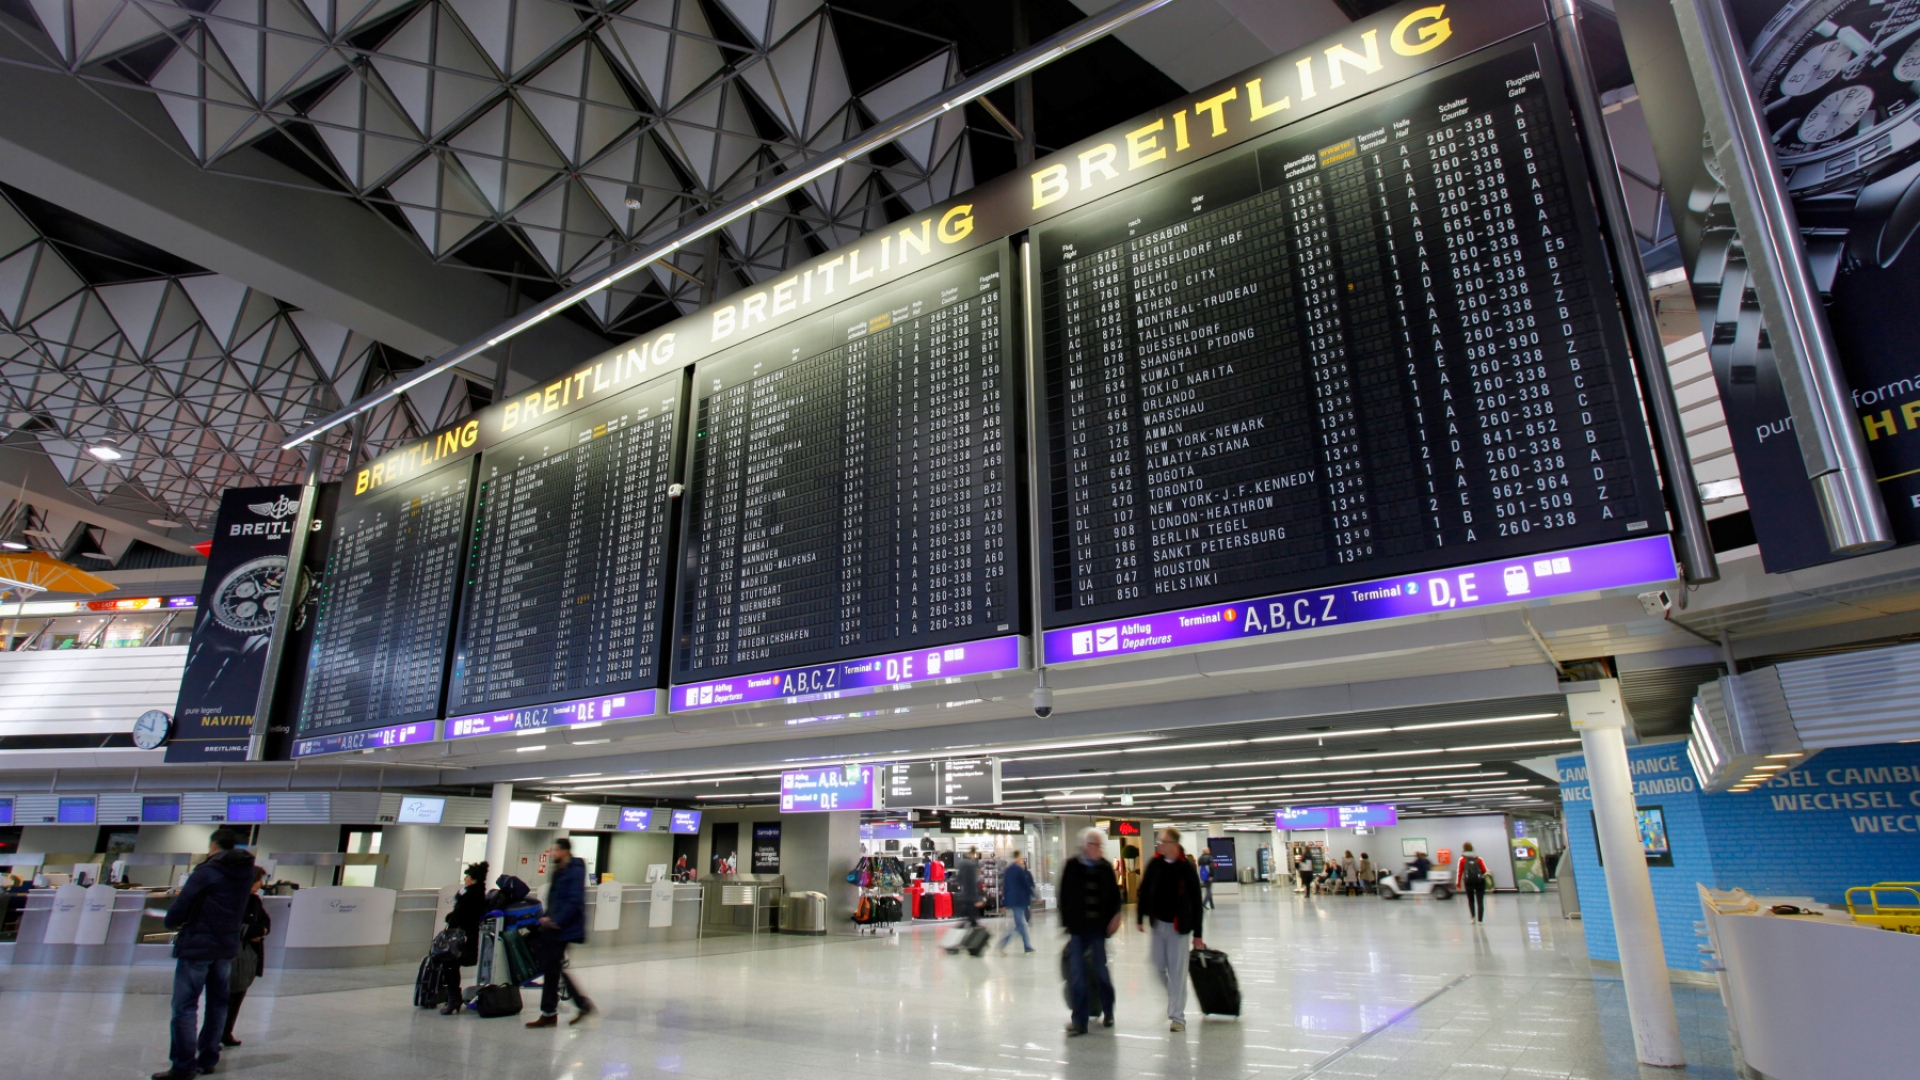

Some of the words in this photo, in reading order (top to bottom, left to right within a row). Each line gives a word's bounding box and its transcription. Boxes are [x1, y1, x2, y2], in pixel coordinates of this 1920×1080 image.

[1506, 71, 1540, 88] Flugsteig
[1508, 86, 1526, 98] Gate
[1032, 4, 1452, 209] BREITLING
[1438, 98, 1468, 112] Schalter
[1441, 107, 1469, 122] Counter
[1358, 127, 1385, 142] Terminal
[1360, 136, 1388, 152] Terminal
[1320, 141, 1351, 156] erwartet
[1322, 148, 1356, 166] estimated
[1131, 223, 1187, 250] LISSABON
[1427, 114, 1492, 145] 260-338
[1132, 240, 1172, 263] BEIRUT
[1133, 241, 1210, 275] DUESSELDORF
[1220, 230, 1241, 245] HBF
[711, 204, 974, 342] BREITLING
[1102, 325, 1121, 339] 875
[1137, 283, 1256, 328] MONTREAL-TRUDEAU
[1444, 203, 1511, 232] 665-678
[1134, 270, 1167, 288] DELHI
[1135, 280, 1177, 301] MEXICO
[1185, 267, 1215, 285] CITX
[1070, 378, 1082, 389] MU
[1104, 365, 1124, 379] 220
[1140, 345, 1197, 369] SHANGHAI
[1207, 328, 1254, 349] PTDONG
[1395, 284, 1402, 295] 2
[1422, 276, 1431, 287] D
[1453, 250, 1521, 278] 854-859
[1545, 237, 1564, 252] E5
[1136, 296, 1171, 314] ATHEN
[1138, 318, 1188, 341] TALLINN
[1138, 323, 1218, 355] DUESSELDORF
[501, 332, 676, 432] BREITLING
[1141, 362, 1184, 382] KUWAIT
[1142, 379, 1178, 396] TOKIO
[1187, 364, 1233, 384] NARITA
[1109, 435, 1128, 448] 126
[1145, 423, 1182, 439] AMMAN
[1467, 332, 1538, 359] 988-990
[1143, 389, 1194, 411] ORLANDO
[751, 395, 803, 419] PHILADELPHIA
[1108, 421, 1127, 435] 378
[1144, 402, 1203, 425] WARSCHAU
[1146, 441, 1167, 454] NEW
[1177, 418, 1263, 446] YORK-NEWARK
[1756, 416, 1792, 443] pur
[355, 420, 479, 495] BREITLING
[1147, 437, 1248, 469] ALMATY-ASTANA
[1076, 519, 1089, 530] DL
[1114, 509, 1133, 522] 107
[1150, 501, 1172, 514] NEW
[1182, 471, 1314, 507] YORK-J.F.KENNEDY
[1483, 419, 1556, 445] 841-852
[1148, 466, 1194, 484] BOGOTA
[1150, 478, 1202, 499] TORONTO
[1115, 555, 1136, 568] 246
[1153, 544, 1190, 561] SANKT
[1201, 527, 1284, 552] PETERSBURG
[1493, 474, 1568, 498] 962-964
[1151, 496, 1272, 530] LONDON-HEATHROW
[1079, 578, 1092, 590] UA
[1116, 570, 1136, 584] 047
[1154, 558, 1209, 576] HOUSTON
[1434, 516, 1439, 528] 1
[1463, 510, 1472, 523] B
[1496, 492, 1572, 517] 501-509
[1597, 485, 1608, 499] Z
[1152, 528, 1198, 546] BERLIN
[1208, 518, 1247, 534] TEGEL
[1155, 573, 1217, 592] HELSINKI
[1179, 612, 1221, 628] Terminal
[1352, 584, 1401, 602] Terminal
[1121, 622, 1151, 636] Abflug
[1122, 634, 1172, 649] Departures
[748, 676, 772, 688] Terminal
[844, 663, 872, 674] Terminal
[714, 682, 732, 694] Abflug
[714, 692, 742, 702] Departures
[200, 706, 222, 715] legend
[201, 716, 254, 726] NAVITIM
[1559, 766, 1588, 782] CAM
[1630, 756, 1679, 775] HANGE
[1826, 766, 1920, 786] CAMBI
[1561, 786, 1592, 802] WEC
[1770, 791, 1902, 810] WECHSEL
[1909, 790, 1920, 807] C
[950, 817, 984, 830] AIRPORT
[986, 819, 1021, 832] BOUTIQUE
[1851, 815, 1920, 833] WEC
